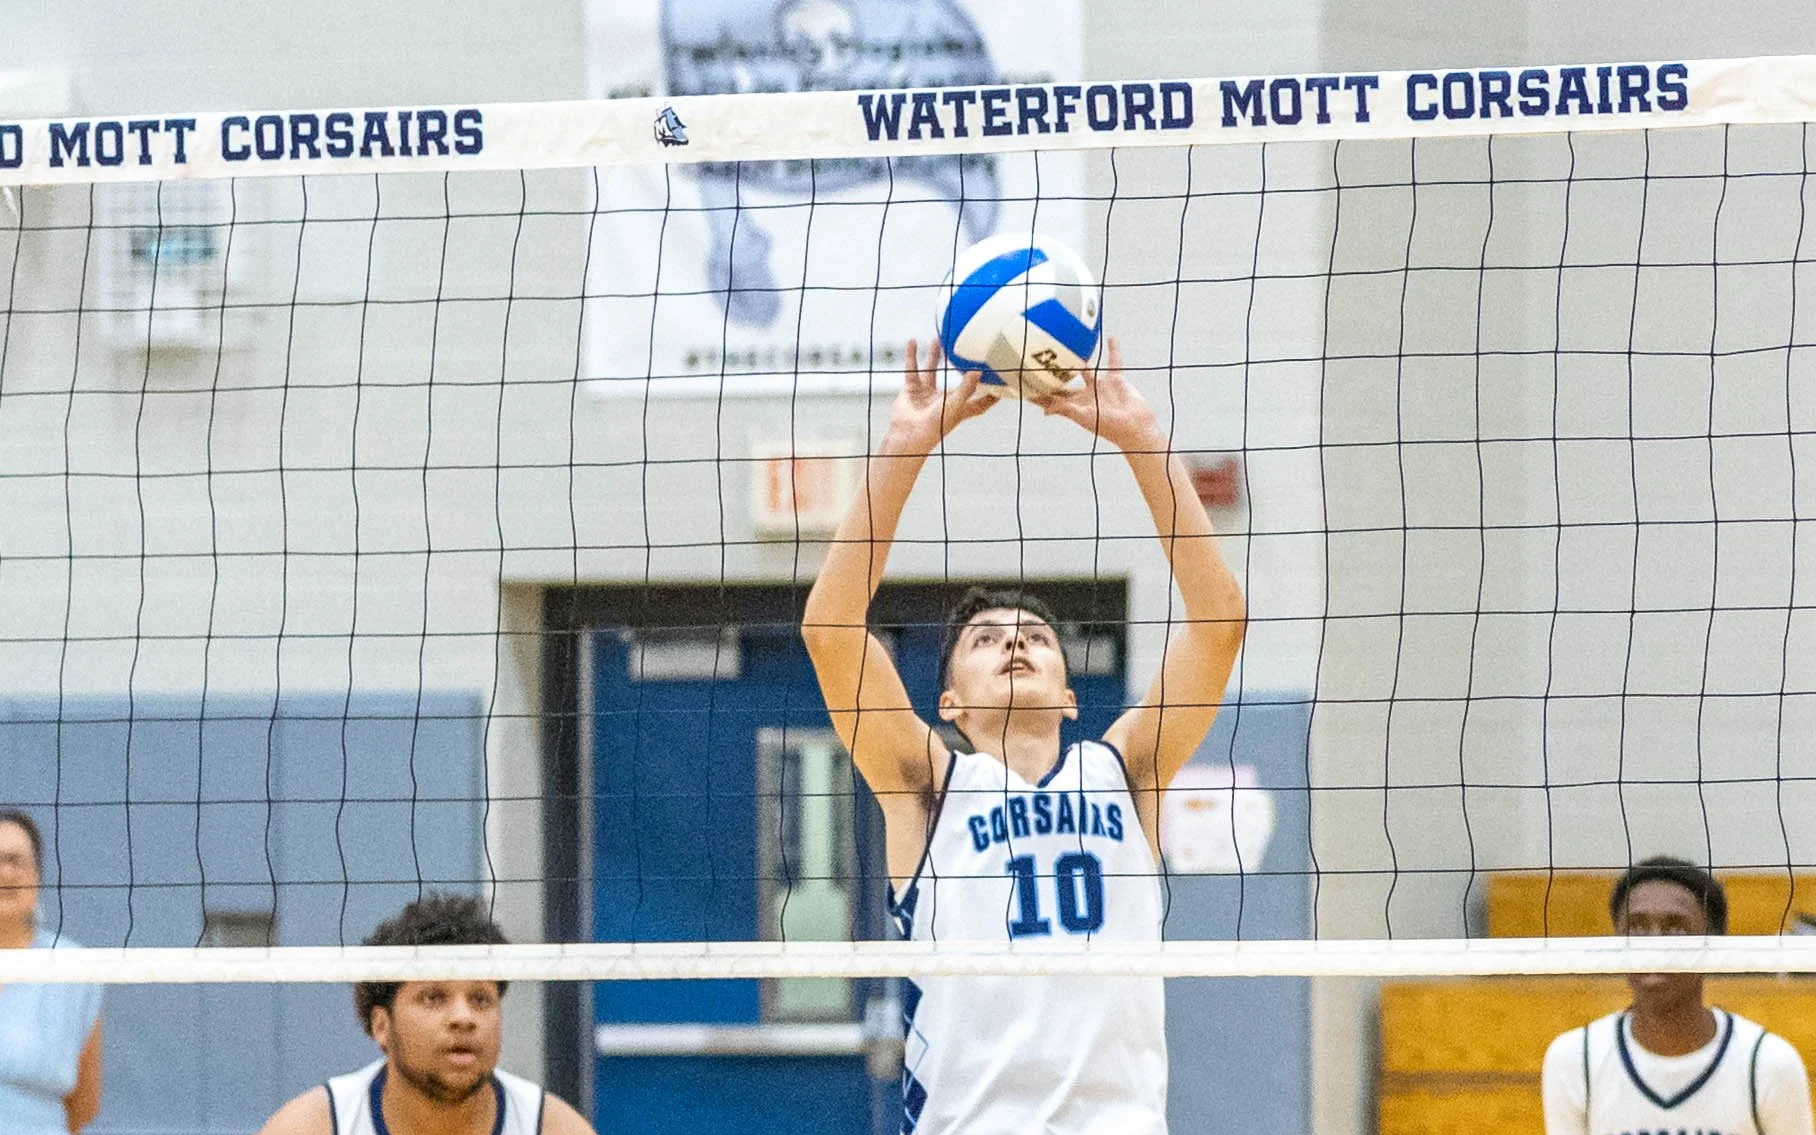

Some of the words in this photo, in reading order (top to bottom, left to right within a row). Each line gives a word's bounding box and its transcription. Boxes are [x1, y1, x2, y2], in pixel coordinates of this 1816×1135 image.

[857, 82, 1193, 141] WATERFORD
[1220, 75, 1380, 127] MOTT
[1405, 63, 1690, 121] CORSAIRS
[48, 118, 196, 168] MOTT
[221, 108, 484, 162] CORSAIRS
[968, 791, 1124, 852] CORSAIRS
[1006, 853, 1105, 938] 10
